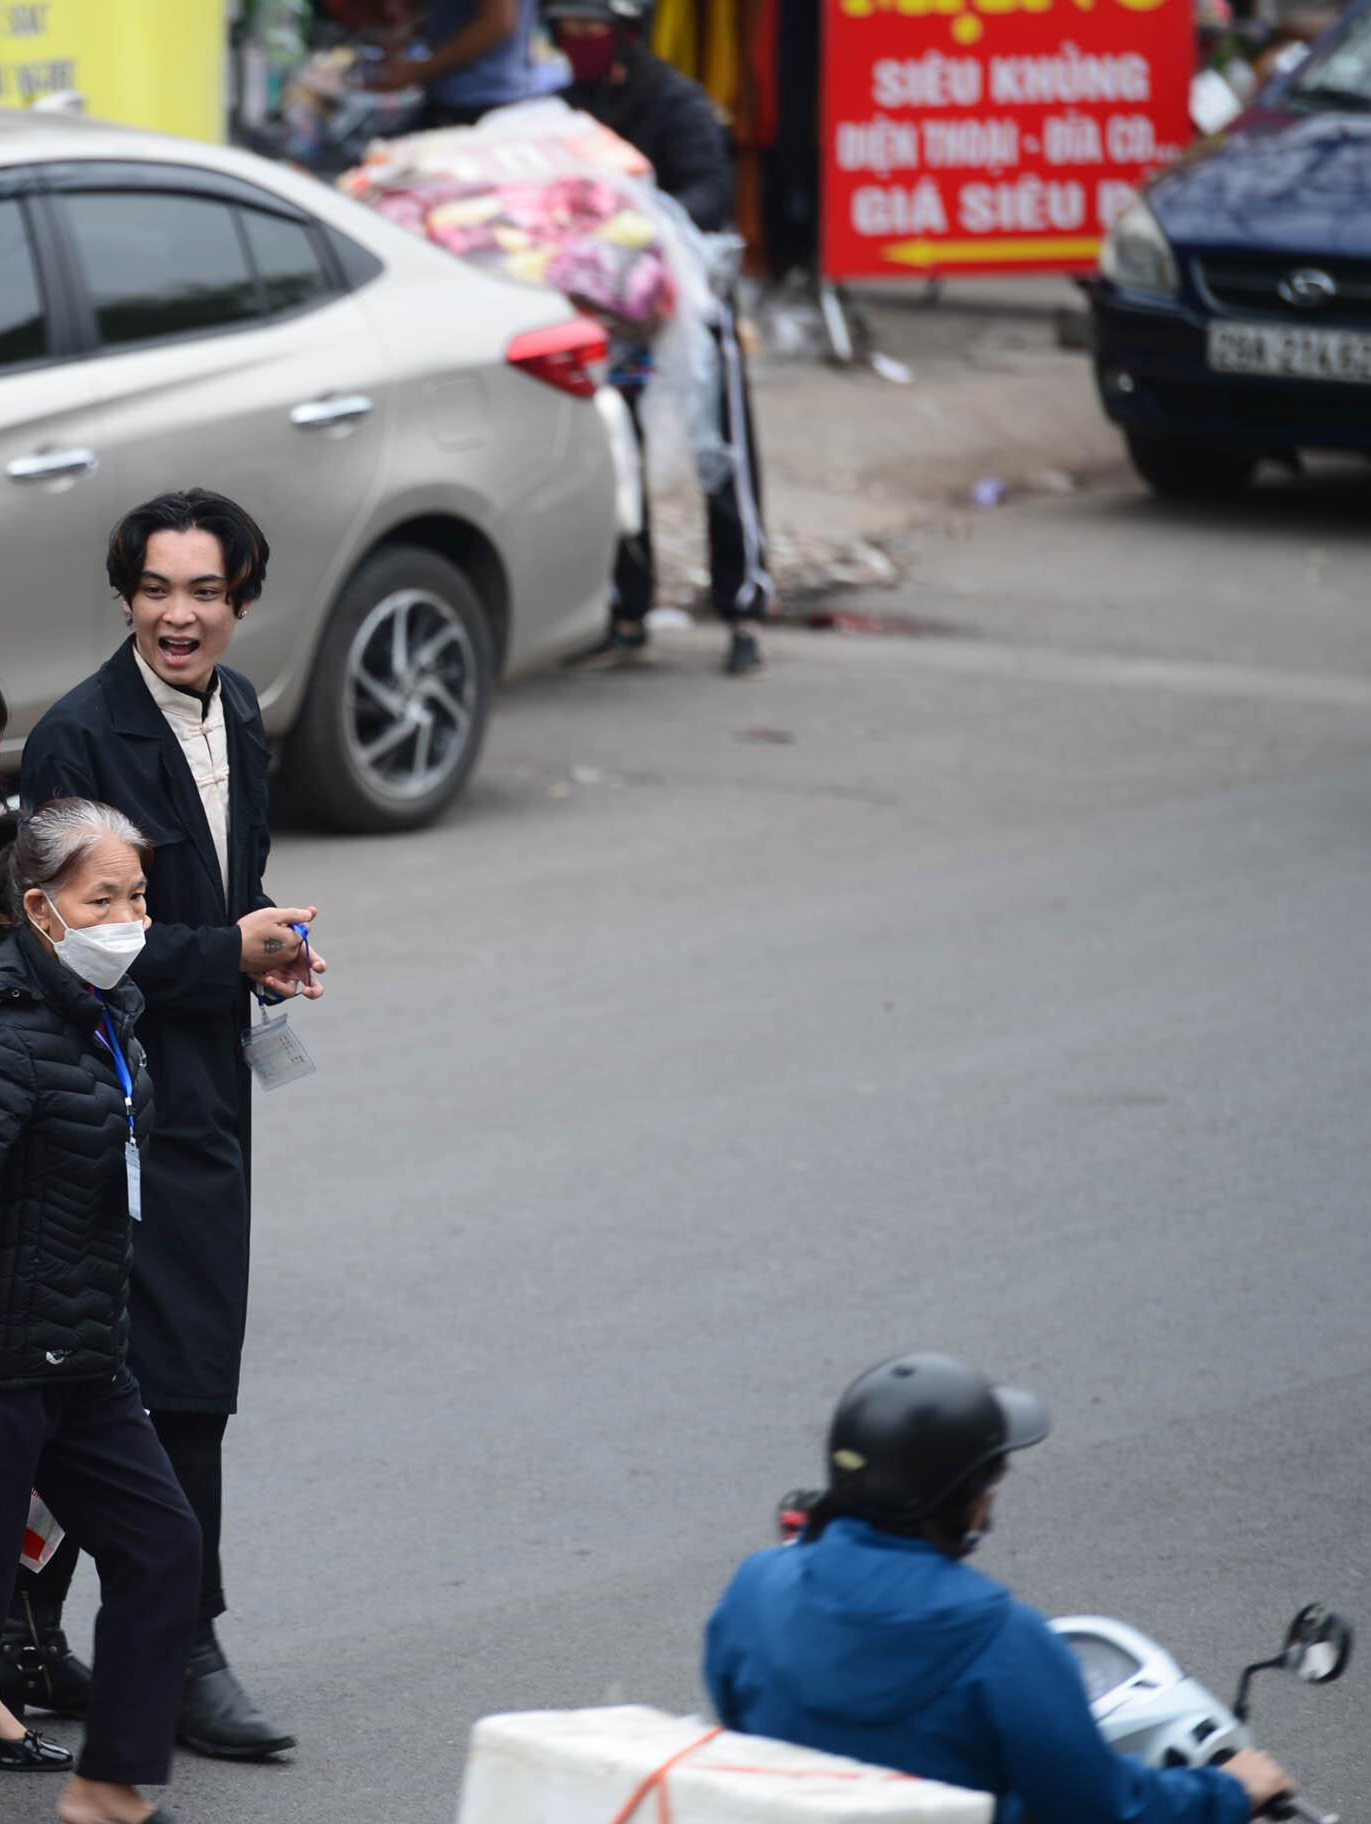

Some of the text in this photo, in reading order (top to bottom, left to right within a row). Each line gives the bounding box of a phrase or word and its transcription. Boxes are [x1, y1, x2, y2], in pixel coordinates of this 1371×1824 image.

[873, 40, 1151, 107] SIÊU KHỦNG
[851, 175, 949, 236] GIÁ
[959, 172, 1086, 233] SIÊU
